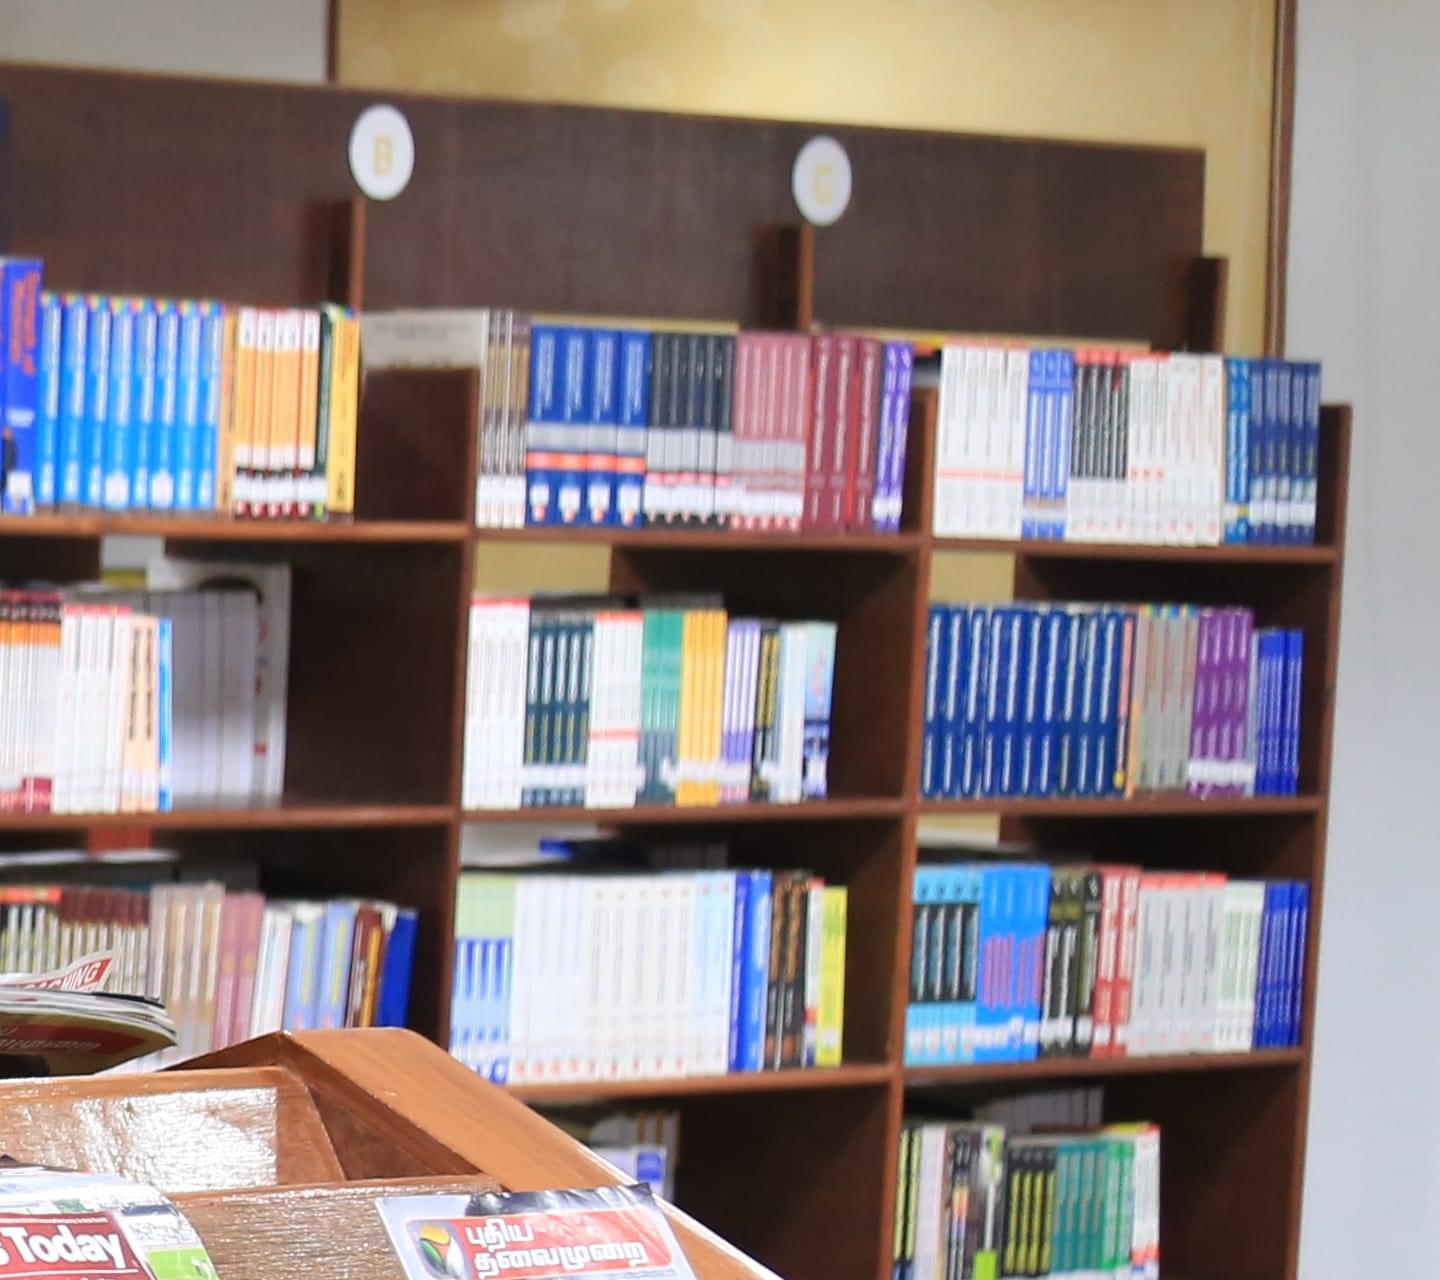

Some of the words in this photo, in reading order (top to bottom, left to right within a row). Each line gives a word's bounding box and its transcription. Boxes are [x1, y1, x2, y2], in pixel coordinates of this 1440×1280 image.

[372, 135, 394, 177] B
[0, 1224, 127, 1269] Today
[464, 1216, 535, 1253] புதிய
[473, 1241, 650, 1280] தலைமுறை
